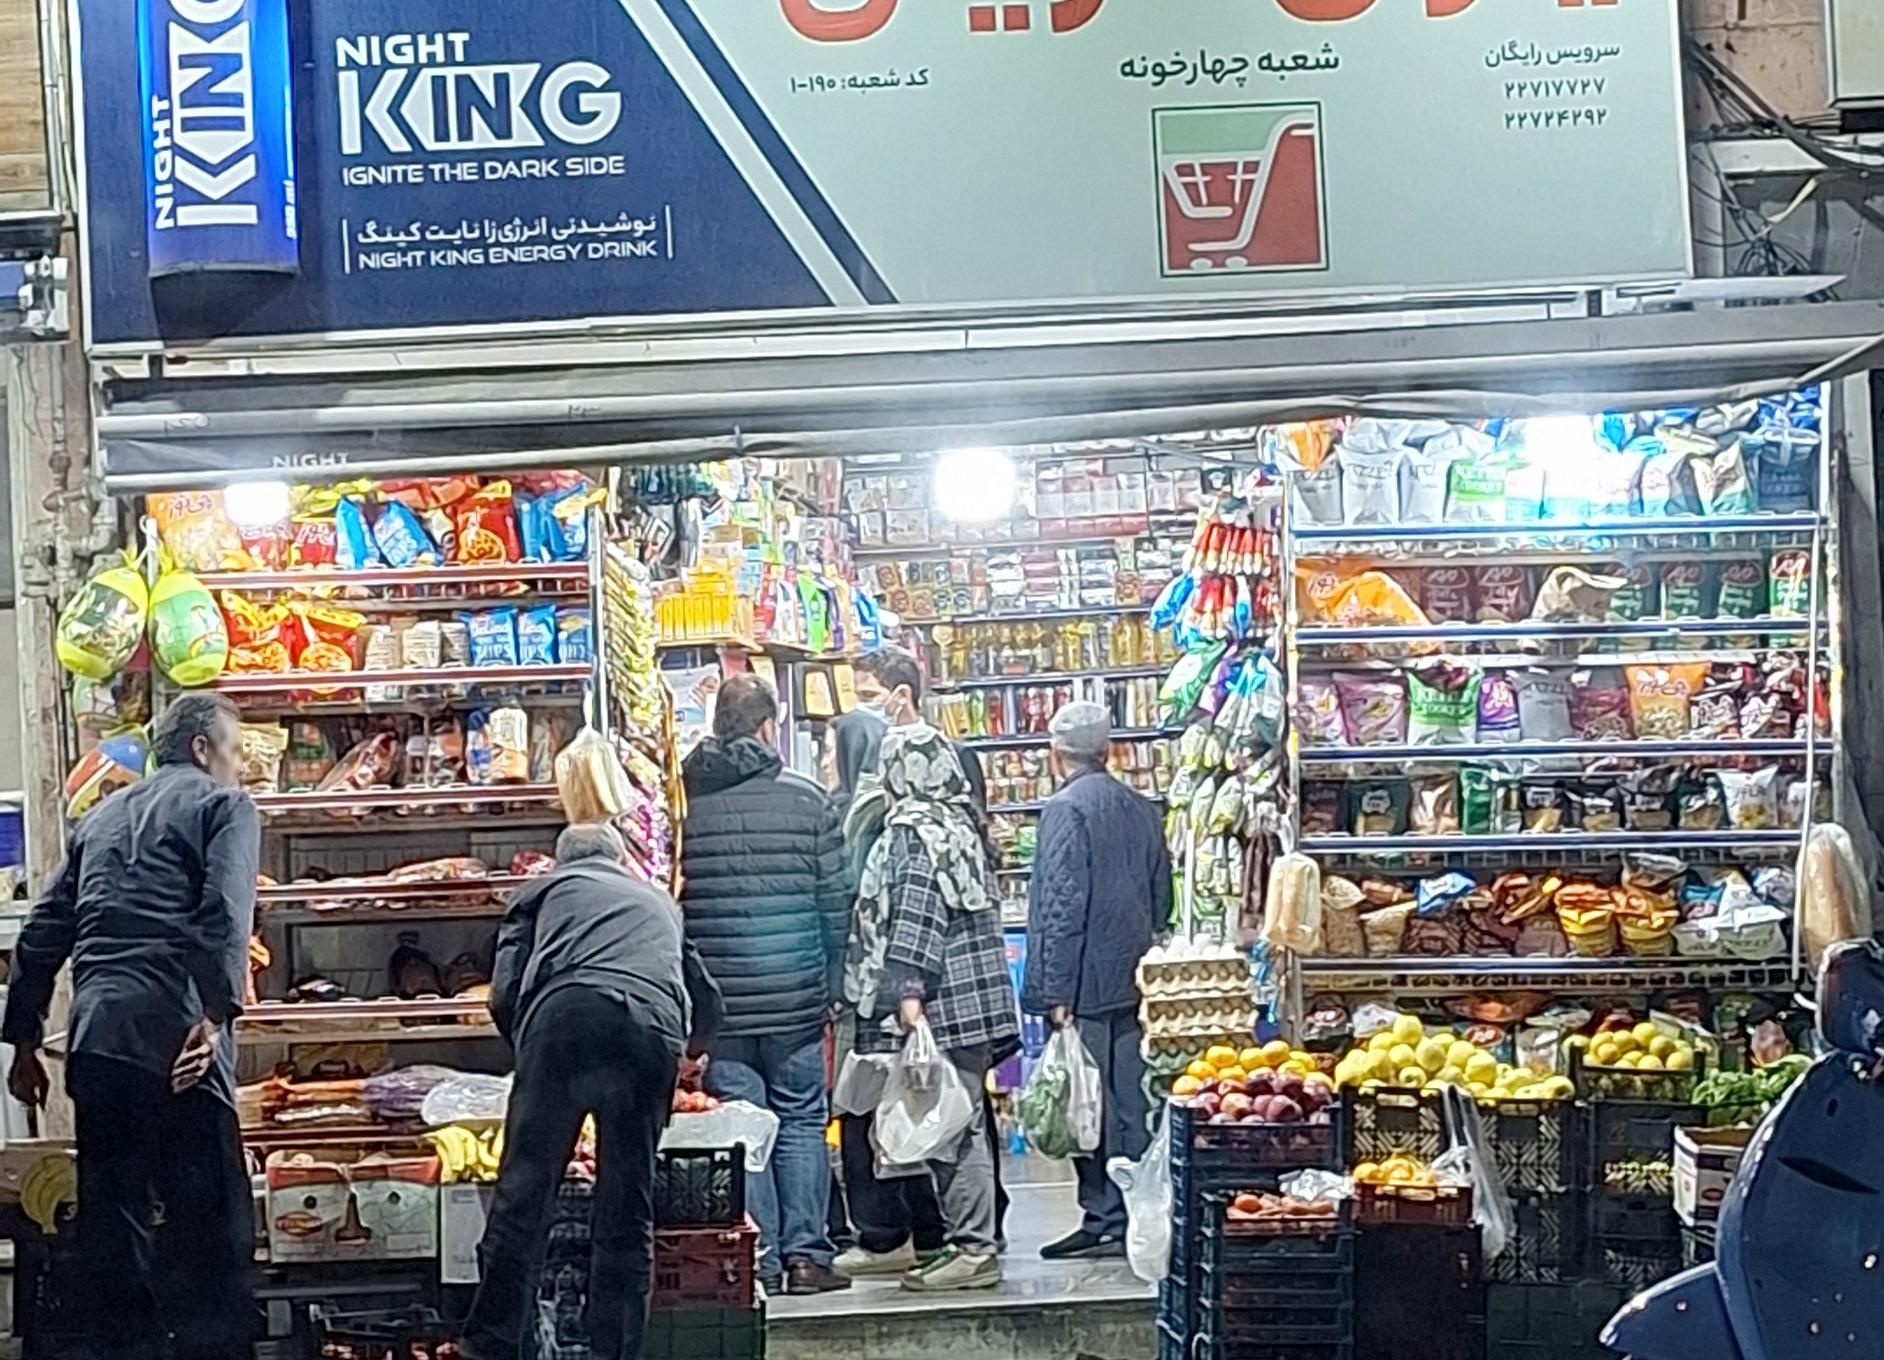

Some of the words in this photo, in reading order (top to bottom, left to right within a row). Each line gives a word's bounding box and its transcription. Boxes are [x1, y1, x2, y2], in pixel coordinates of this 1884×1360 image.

[335, 31, 470, 68] NIGHT
[1257, 42, 1340, 82] شعبه
[1484, 40, 1542, 68] رایگان
[1546, 45, 1620, 65] سرویس
[904, 68, 929, 87] کد
[1119, 48, 1250, 88] چهارخونه
[1504, 77, 1606, 100] ۲۲۷۱۷۷۲۷
[337, 60, 622, 156] KING
[1504, 107, 1607, 130] ۲۲۷۲۴۲۹۲
[151, 94, 174, 230] NIGHT
[342, 163, 424, 186] IGNITE
[428, 162, 479, 182] THE
[484, 158, 560, 180] DARK
[565, 155, 626, 177] SIDE
[357, 220, 422, 248] کینگ
[424, 220, 481, 245] نایت
[551, 211, 657, 241] نوشیدنی
[358, 250, 426, 270] NIGHT
[429, 248, 485, 267] KING
[488, 242, 583, 264] ENERGY
[587, 239, 658, 259] DRINK
[271, 451, 350, 469] NIGHT
